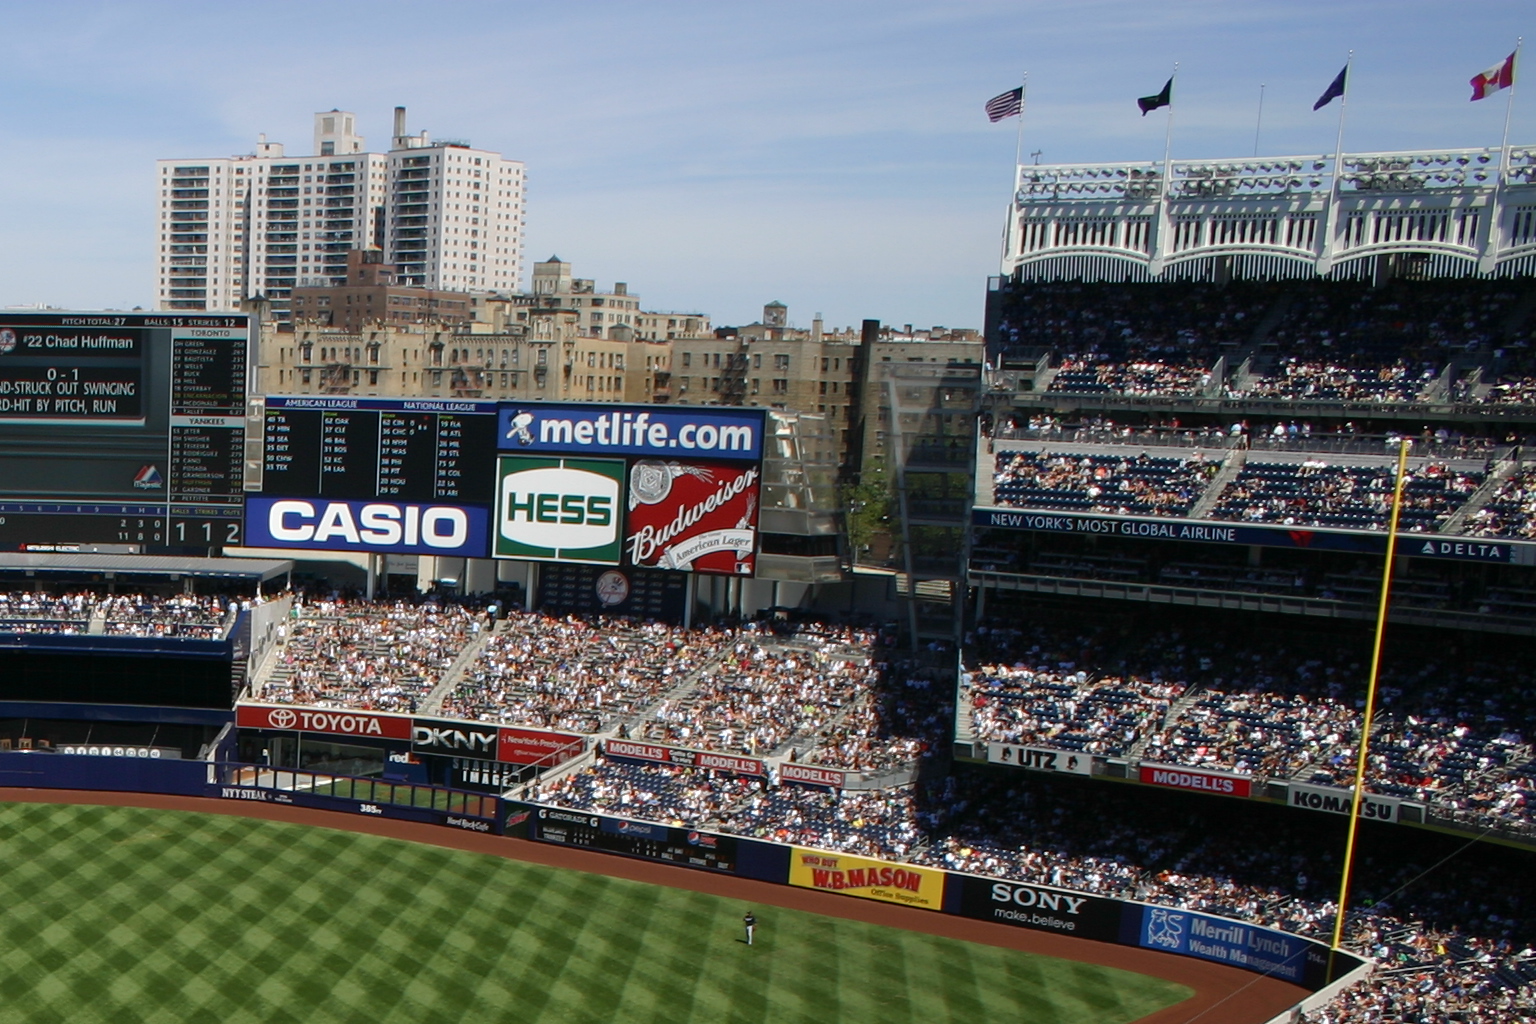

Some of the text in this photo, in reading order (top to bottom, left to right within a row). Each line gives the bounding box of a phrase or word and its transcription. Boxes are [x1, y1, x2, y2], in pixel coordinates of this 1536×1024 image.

[114, 317, 126, 326] 27
[172, 318, 184, 326] 15
[224, 319, 236, 327] 12
[45, 335, 79, 349] Chad
[81, 335, 134, 350] Huffman
[46, 368, 79, 381] 0 1
[56, 382, 78, 395] OUT
[83, 382, 135, 396] SWINGING
[36, 399, 50, 412] BY
[54, 399, 88, 414] PITCH,
[92, 400, 117, 413] RUN
[328, 400, 357, 408] LEAGUE
[403, 402, 476, 411] NATIONAL LEAGUE
[539, 412, 753, 451] metlife.com
[508, 492, 612, 527] HESS
[626, 465, 760, 565] Budweiser
[176, 522, 239, 543] 1 1 2
[268, 500, 468, 549] CASIO
[990, 513, 1236, 542] NEW YORK'S MOST GLOBAL AIRLINE
[118, 532, 129, 540] 11
[675, 538, 720, 562] American
[721, 535, 751, 547] Lager
[1440, 542, 1501, 558] DELTA
[300, 712, 383, 735] TOYOTA
[413, 726, 497, 752] DKNY
[609, 742, 664, 759] MODELL'S
[1017, 748, 1057, 770] UTZ
[700, 755, 757, 772] MODELL'S
[782, 766, 842, 785] MODELL'S
[1152, 769, 1234, 793] MODELL'S
[222, 787, 241, 799] NYY
[241, 789, 267, 801] STEAK
[549, 811, 588, 824] GATORADE
[801, 855, 838, 869] WHO BUT
[870, 887, 929, 906] Office Supplies
[991, 882, 1087, 914] SONY
[994, 906, 1076, 931] make.believe
[1191, 917, 1243, 945] Merrill
[1247, 930, 1289, 958] Lynch
[1189, 939, 1227, 960] Wealth
[1229, 949, 1297, 979] Management
